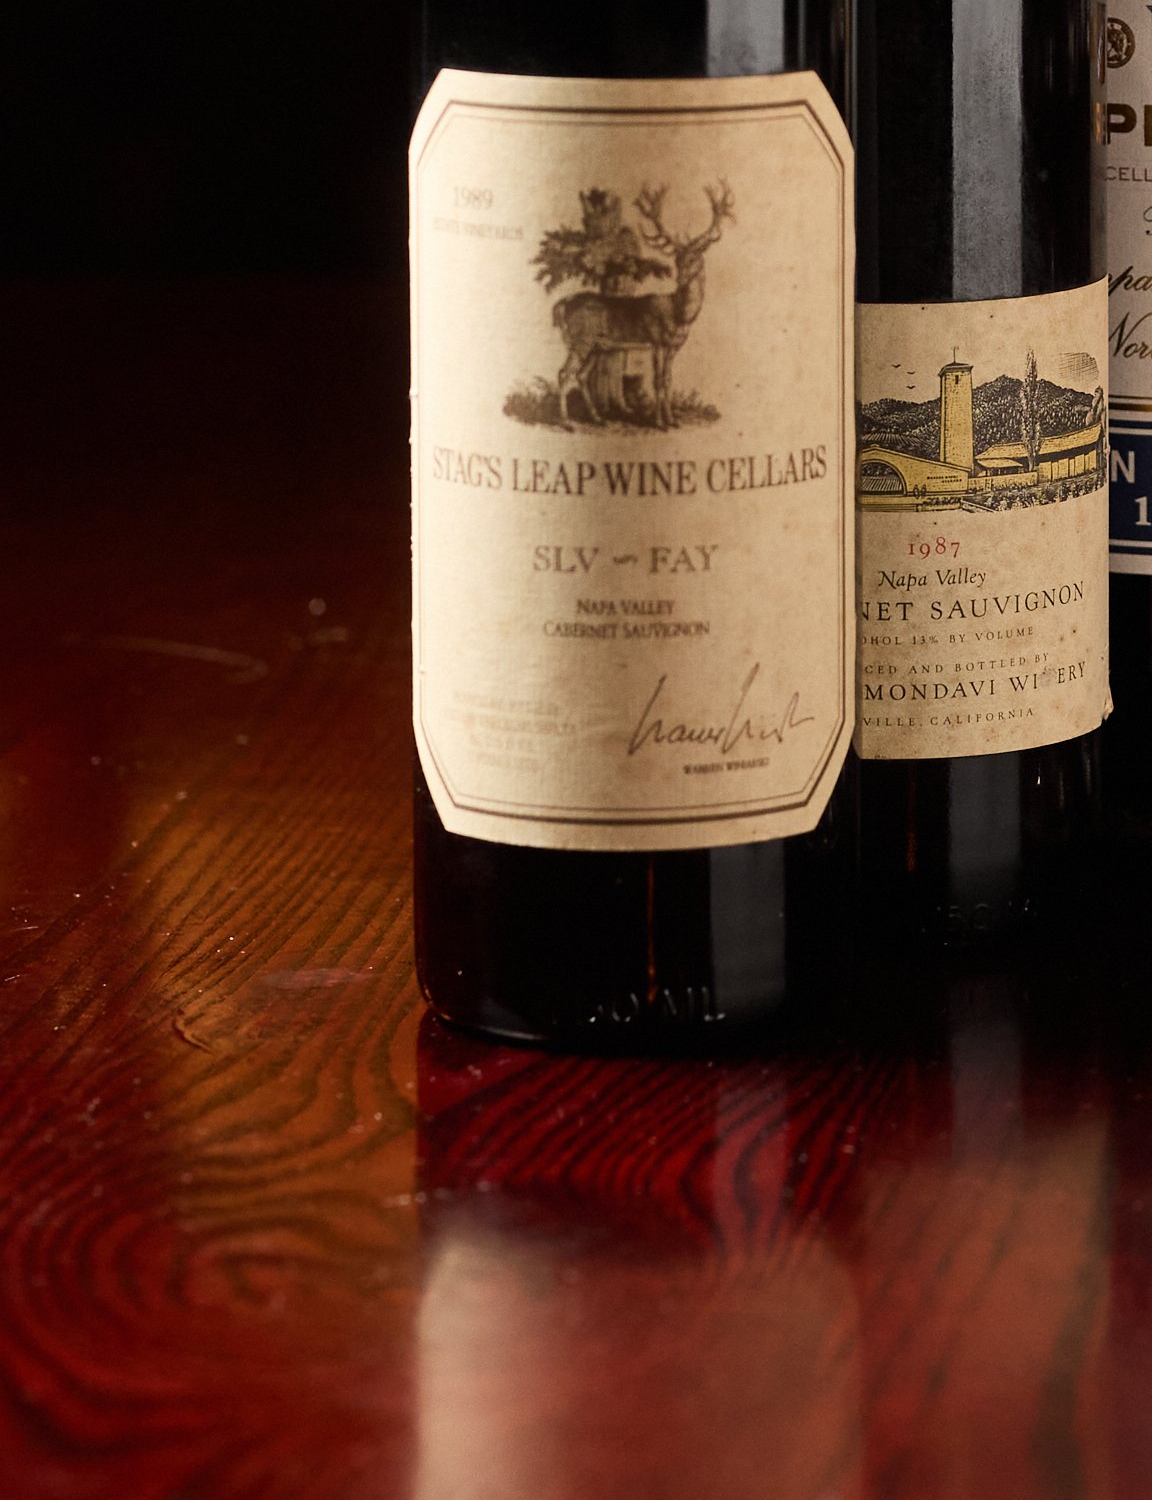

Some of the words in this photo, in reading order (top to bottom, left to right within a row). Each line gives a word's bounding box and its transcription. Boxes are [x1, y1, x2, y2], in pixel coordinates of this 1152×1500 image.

[453, 186, 494, 211] 1989
[433, 445, 503, 490] STAG'S
[512, 457, 597, 496] LEAP
[603, 460, 697, 496] WINE
[706, 444, 828, 493] CELLARS
[533, 545, 600, 574] SLV
[650, 544, 719, 574] FAY
[907, 536, 961, 560] 1987
[878, 570, 928, 592] Napa
[936, 567, 986, 588] Valley
[577, 599, 617, 616] NAPA
[621, 599, 675, 616] VALLEY
[930, 580, 1084, 621] SAUVIGNON
[543, 619, 618, 639] CABERNET
[622, 619, 711, 639] SAUVIGNON
[912, 635, 939, 645] 13%
[949, 633, 966, 644] BY
[975, 626, 1034, 641] VOLUME
[864, 665, 897, 675] CED
[908, 664, 943, 675] AND
[955, 657, 1026, 673] BOTTLED
[1034, 652, 1049, 664] BY
[864, 679, 996, 701] MONDAVI
[1009, 661, 1086, 693] WIERY
[930, 707, 1034, 727] CALIFORNIA
